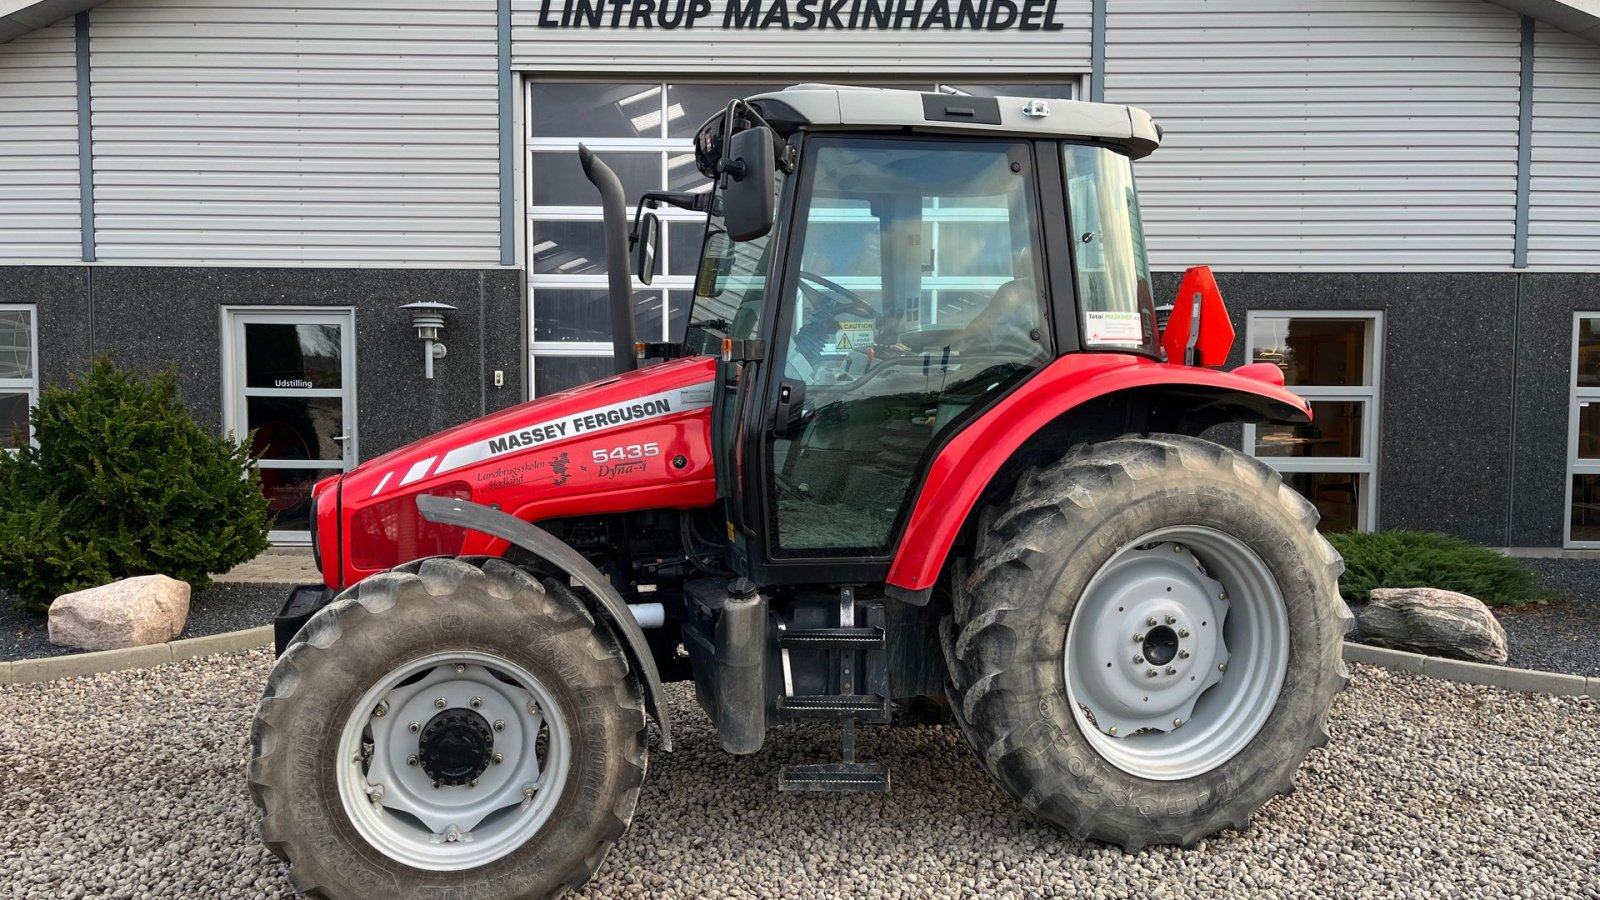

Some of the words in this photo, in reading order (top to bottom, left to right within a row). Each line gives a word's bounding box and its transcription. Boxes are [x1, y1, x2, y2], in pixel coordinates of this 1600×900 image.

[538, 0, 712, 29] LINTRUP
[722, 0, 1064, 31] MASKINHANDEL
[275, 379, 313, 389] Udstilling
[488, 422, 567, 454] MASSEY
[573, 398, 671, 432] FERGUSON
[592, 442, 659, 464] 5435
[477, 460, 545, 481] Landbrugsskolen
[598, 460, 647, 480] Dyna-4
